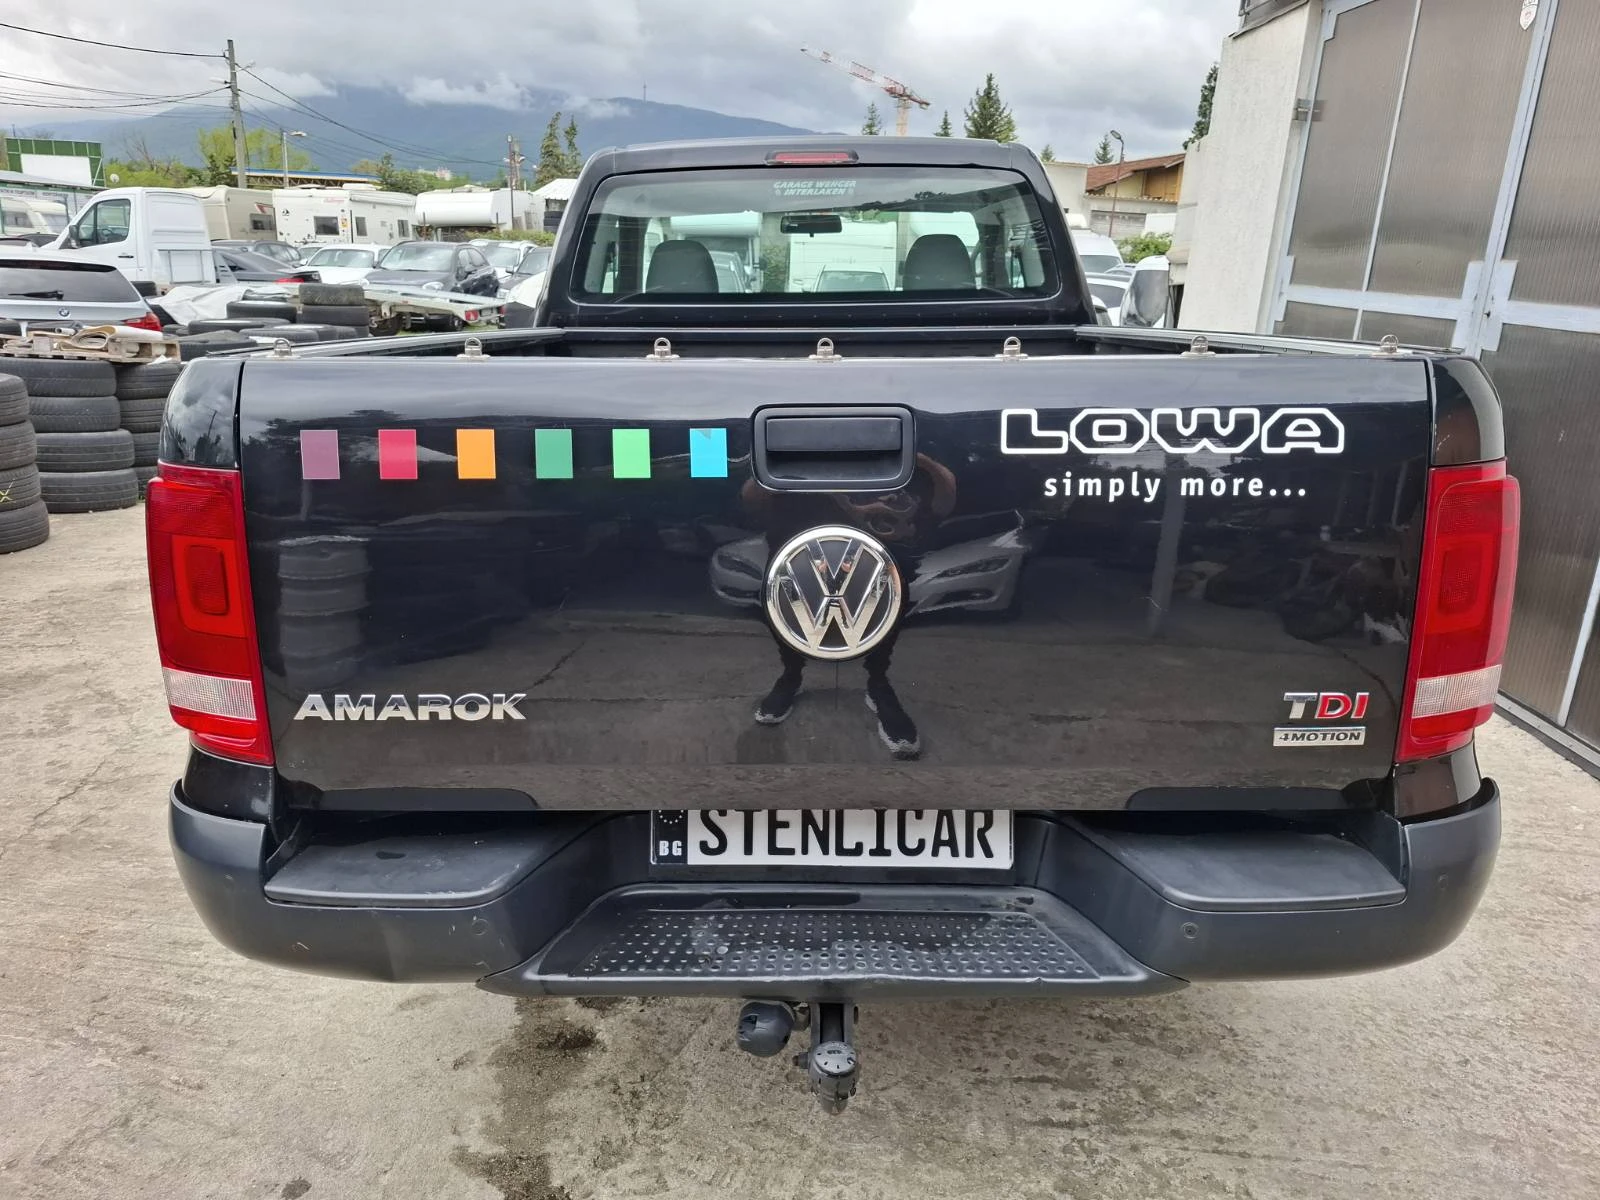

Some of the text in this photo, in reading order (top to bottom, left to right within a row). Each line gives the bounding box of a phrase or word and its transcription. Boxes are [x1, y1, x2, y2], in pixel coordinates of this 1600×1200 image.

[773, 180, 857, 189] GARAGE WENGER
[783, 188, 846, 196] INTERLAKEN
[1001, 408, 1345, 454] LOWA
[1044, 471, 1307, 503] simply more...
[767, 526, 901, 659] VW
[293, 693, 527, 722] AMAROK
[1283, 692, 1370, 719] TDI
[1280, 732, 1361, 742] 4MOTION
[699, 809, 994, 858] STENLICAR
[659, 840, 682, 856] BG
